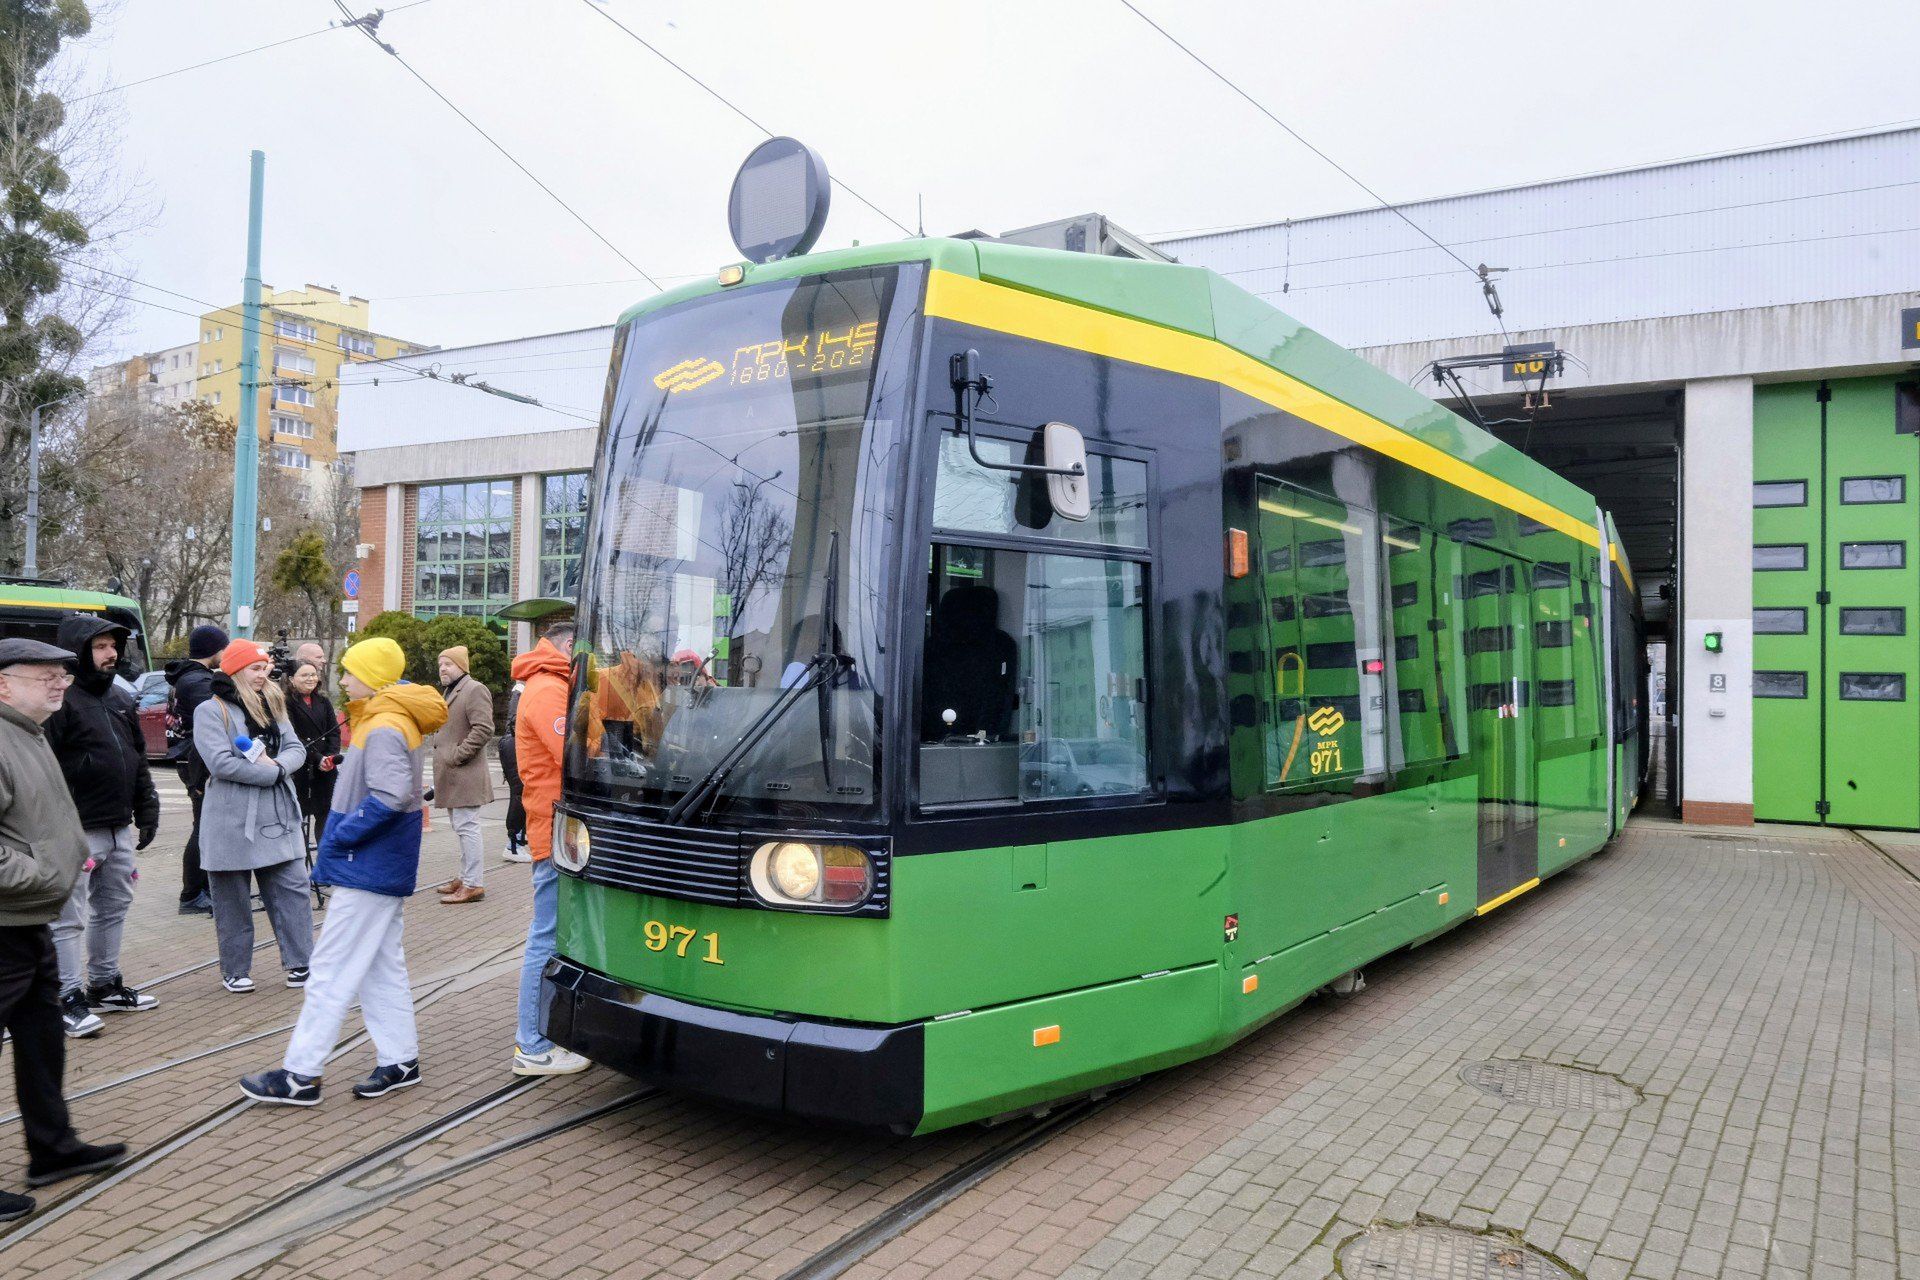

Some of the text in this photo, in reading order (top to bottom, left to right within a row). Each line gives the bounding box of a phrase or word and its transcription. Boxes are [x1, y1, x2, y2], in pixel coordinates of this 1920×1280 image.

[731, 346, 876, 386] 1880-202
[1713, 675, 1723, 687] 8
[1317, 740, 1338, 750] MPK
[1310, 749, 1343, 775] 971
[643, 920, 724, 966] 971
